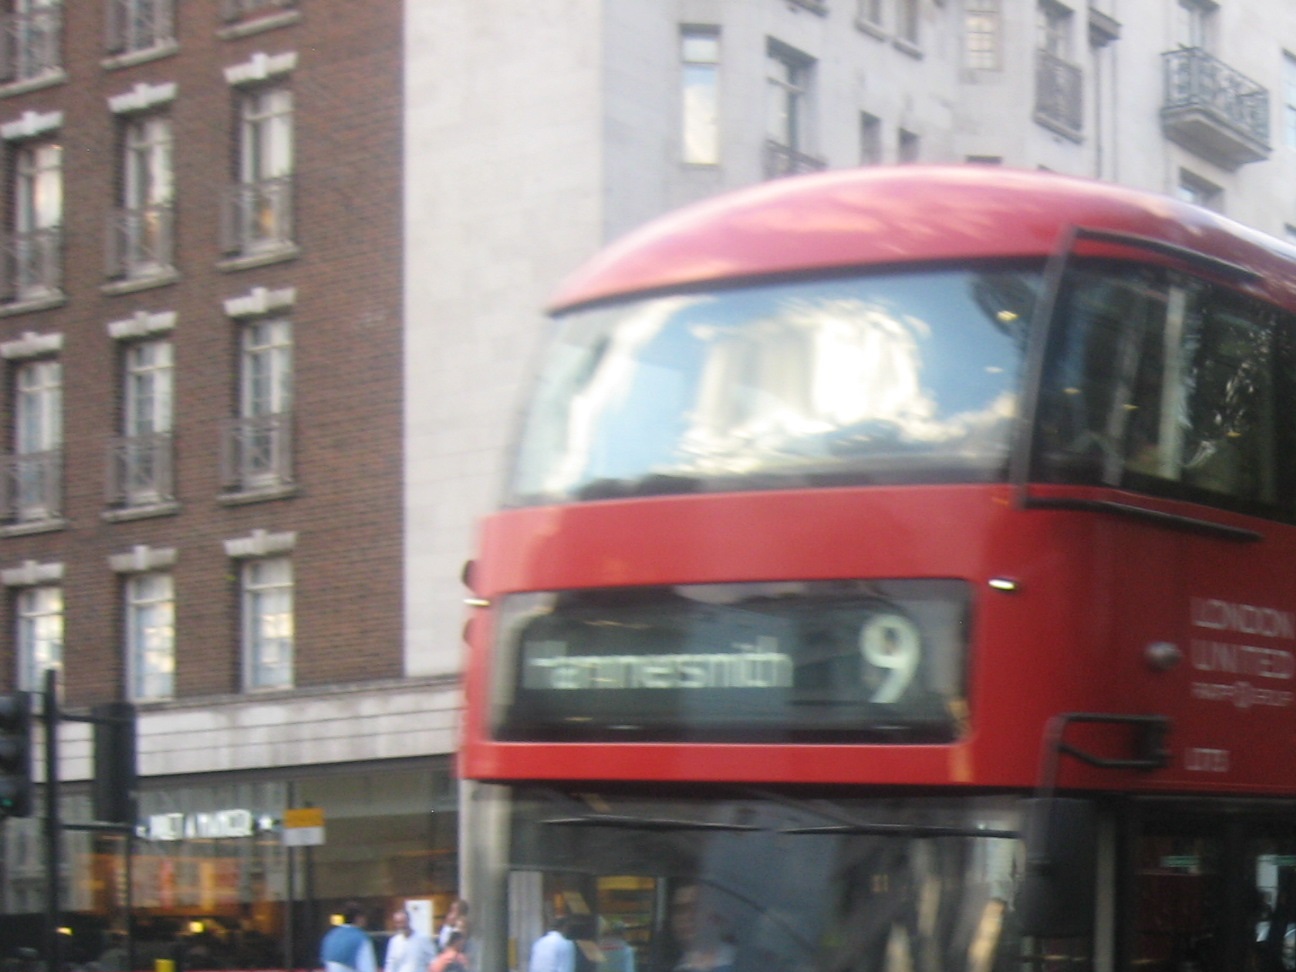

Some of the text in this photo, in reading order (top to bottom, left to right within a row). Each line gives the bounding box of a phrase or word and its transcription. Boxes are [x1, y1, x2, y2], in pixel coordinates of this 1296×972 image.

[1190, 597, 1296, 640] LONDON
[859, 613, 921, 704] 9
[1190, 638, 1296, 680] UNITED
